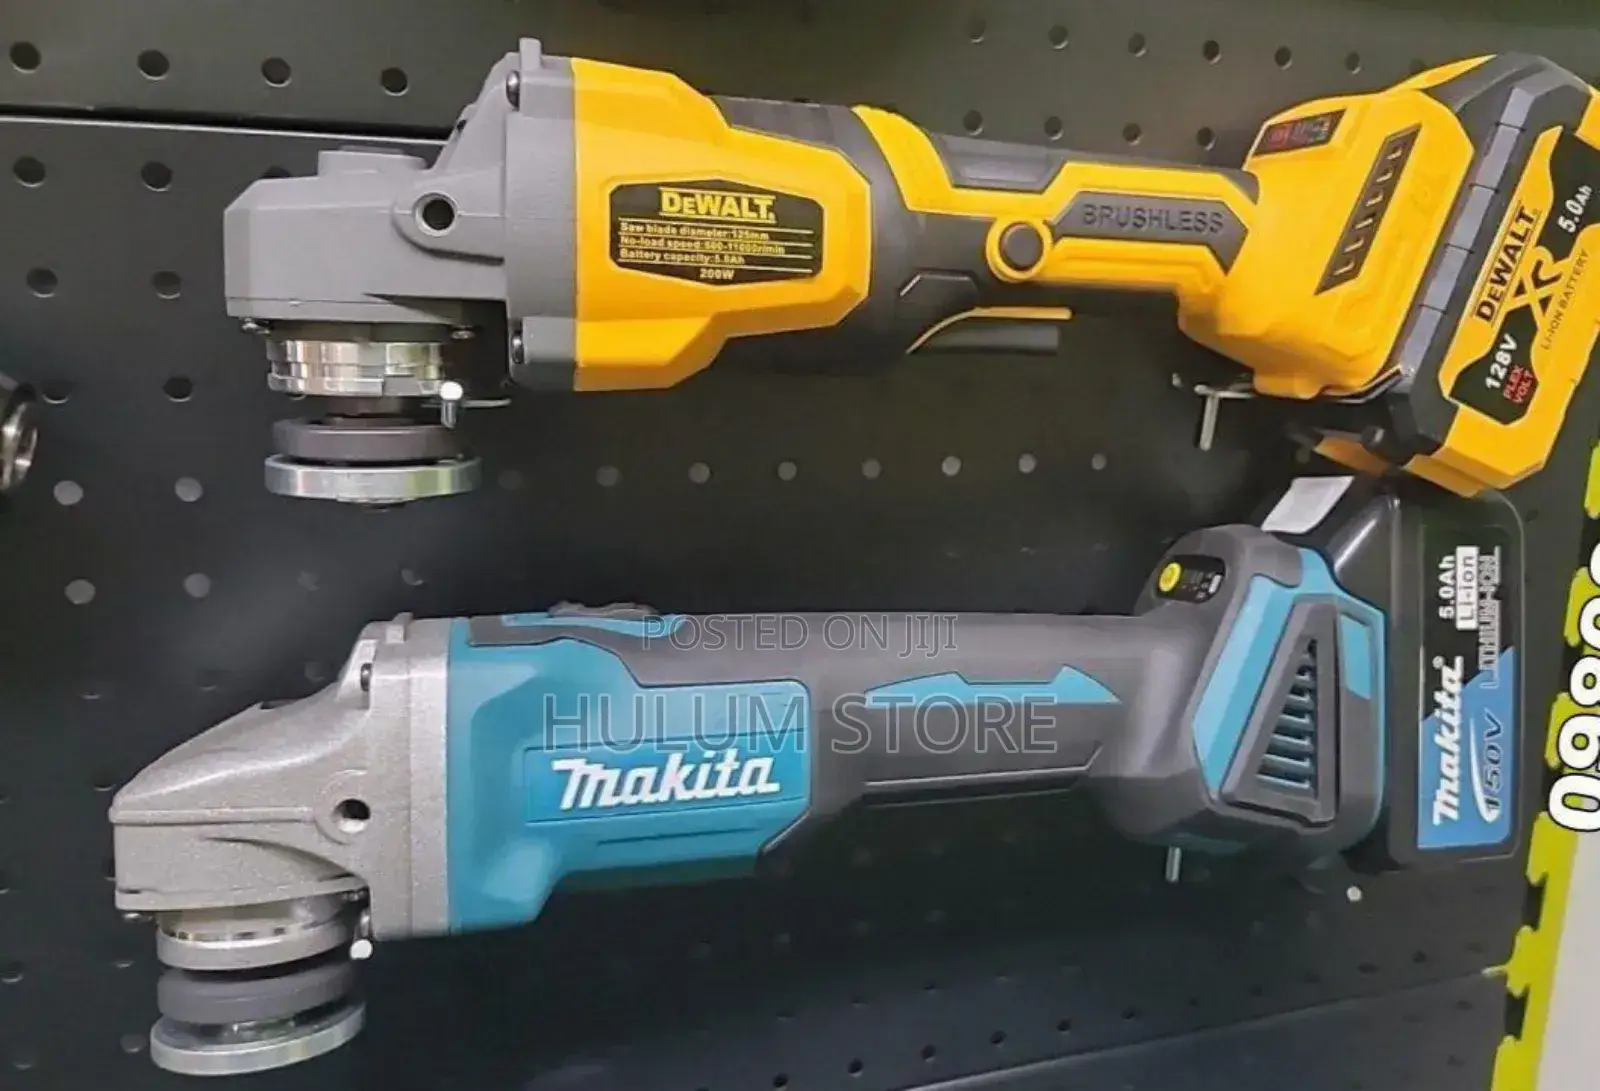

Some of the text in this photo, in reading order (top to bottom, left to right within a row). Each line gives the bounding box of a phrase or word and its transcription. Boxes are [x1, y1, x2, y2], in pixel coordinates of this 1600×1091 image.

[646, 223, 678, 235] blade
[1083, 203, 1224, 234] BRUSHLESS
[1558, 184, 1592, 234] 5.0Ah
[620, 246, 662, 262] Battery
[1562, 249, 1590, 310] BATTERY
[1485, 333, 1517, 388] 128V
[1513, 369, 1533, 403] VOLT
[1438, 555, 1456, 619] 5.0Ah
